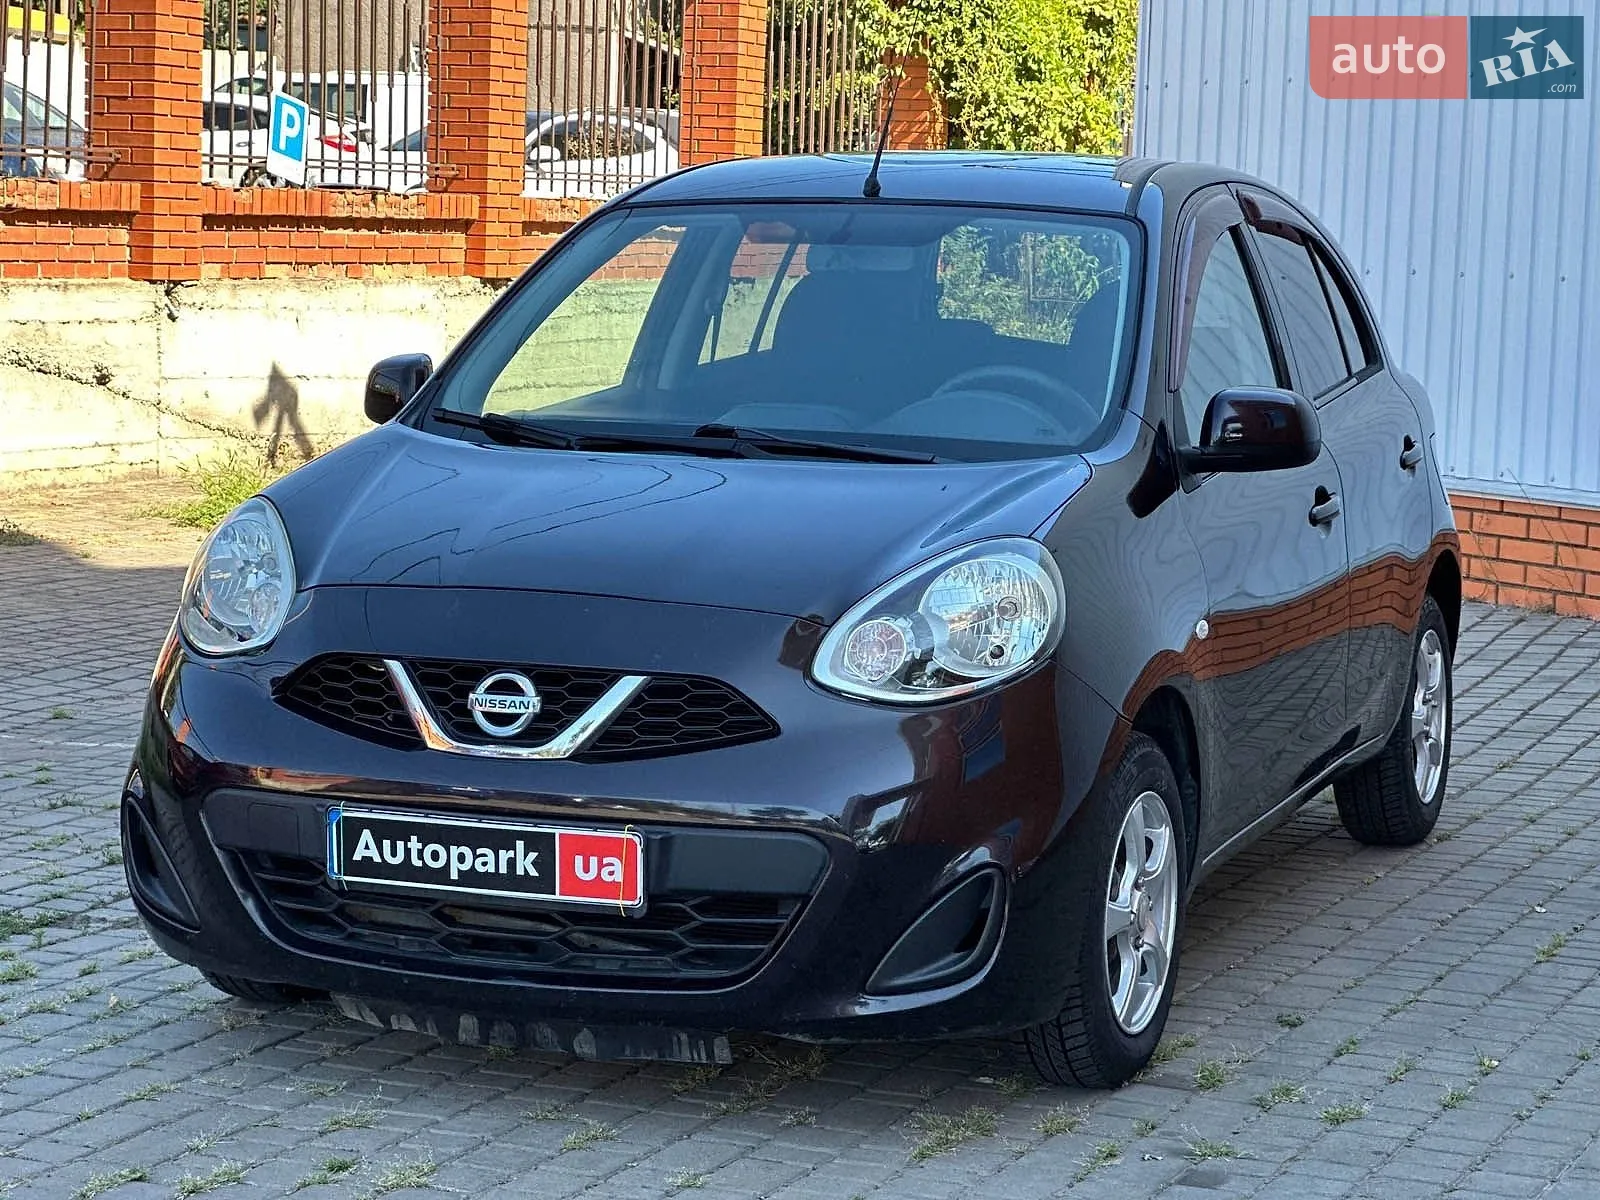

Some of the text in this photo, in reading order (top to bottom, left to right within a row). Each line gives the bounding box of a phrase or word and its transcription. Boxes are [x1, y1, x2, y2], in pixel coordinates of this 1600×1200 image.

[278, 102, 301, 152] P
[473, 697, 531, 710] NISSAN
[352, 828, 623, 883] Autopark ua
